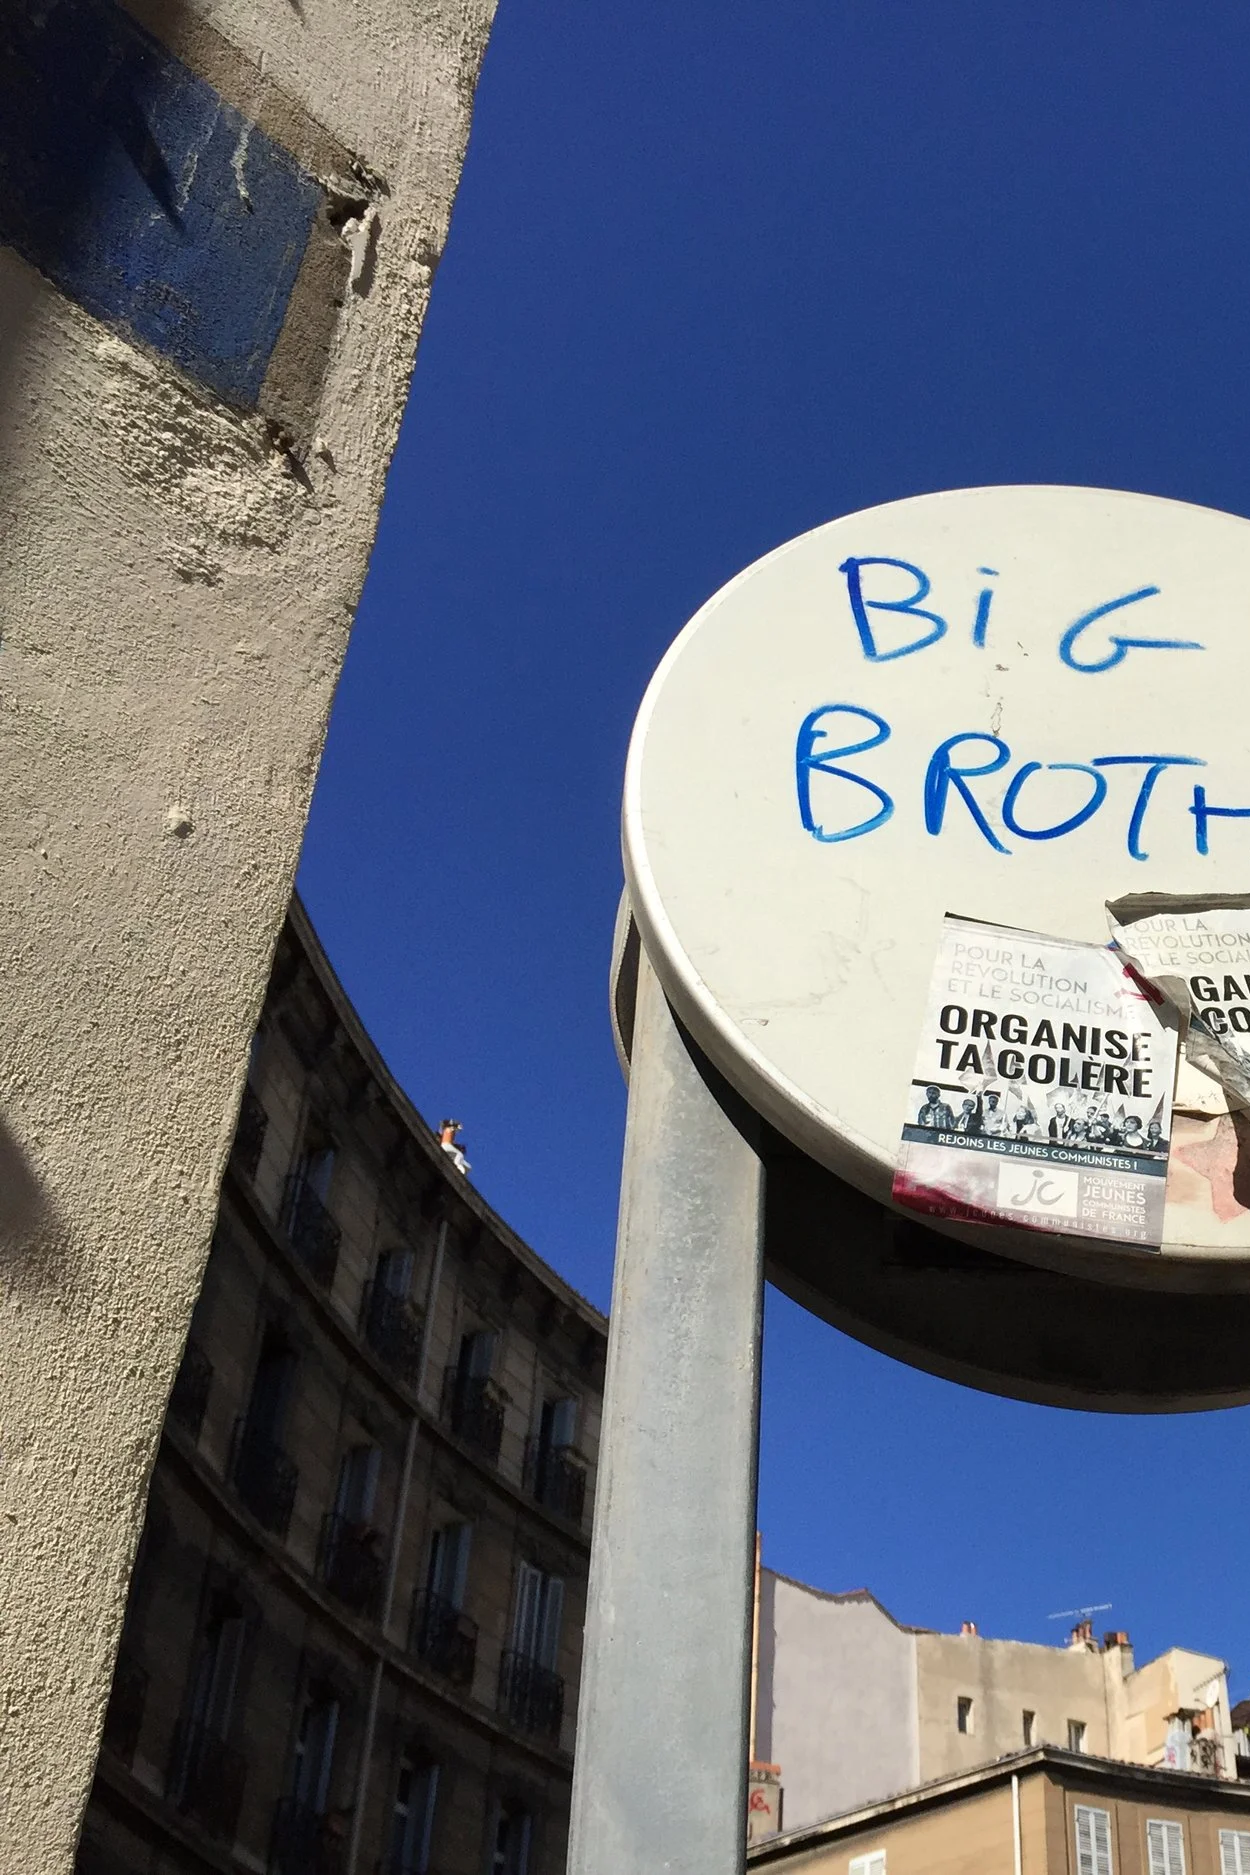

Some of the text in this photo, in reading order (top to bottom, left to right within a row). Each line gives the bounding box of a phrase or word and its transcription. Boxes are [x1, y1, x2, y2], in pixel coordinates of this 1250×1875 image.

[1182, 917, 1209, 932] LA
[954, 943, 1045, 971] POUR LA
[1159, 952, 1181, 966] LE
[948, 978, 973, 994] ET
[979, 983, 1002, 1000] LE
[940, 1004, 1152, 1062] ORGANISE
[936, 1039, 1153, 1098] TA COLÈRE
[938, 1133, 985, 1149] REJOINS
[986, 1139, 1006, 1152] LES
[1008, 1143, 1049, 1158] JEUNES
[1051, 1149, 1131, 1169] COMMUNISTES
[1083, 1176, 1147, 1192] MOUVEMENT
[1083, 1185, 1147, 1205] JEUNES
[1082, 1199, 1147, 1214] COMMUNISTES
[1082, 1207, 1146, 1225] DE FRANCE
